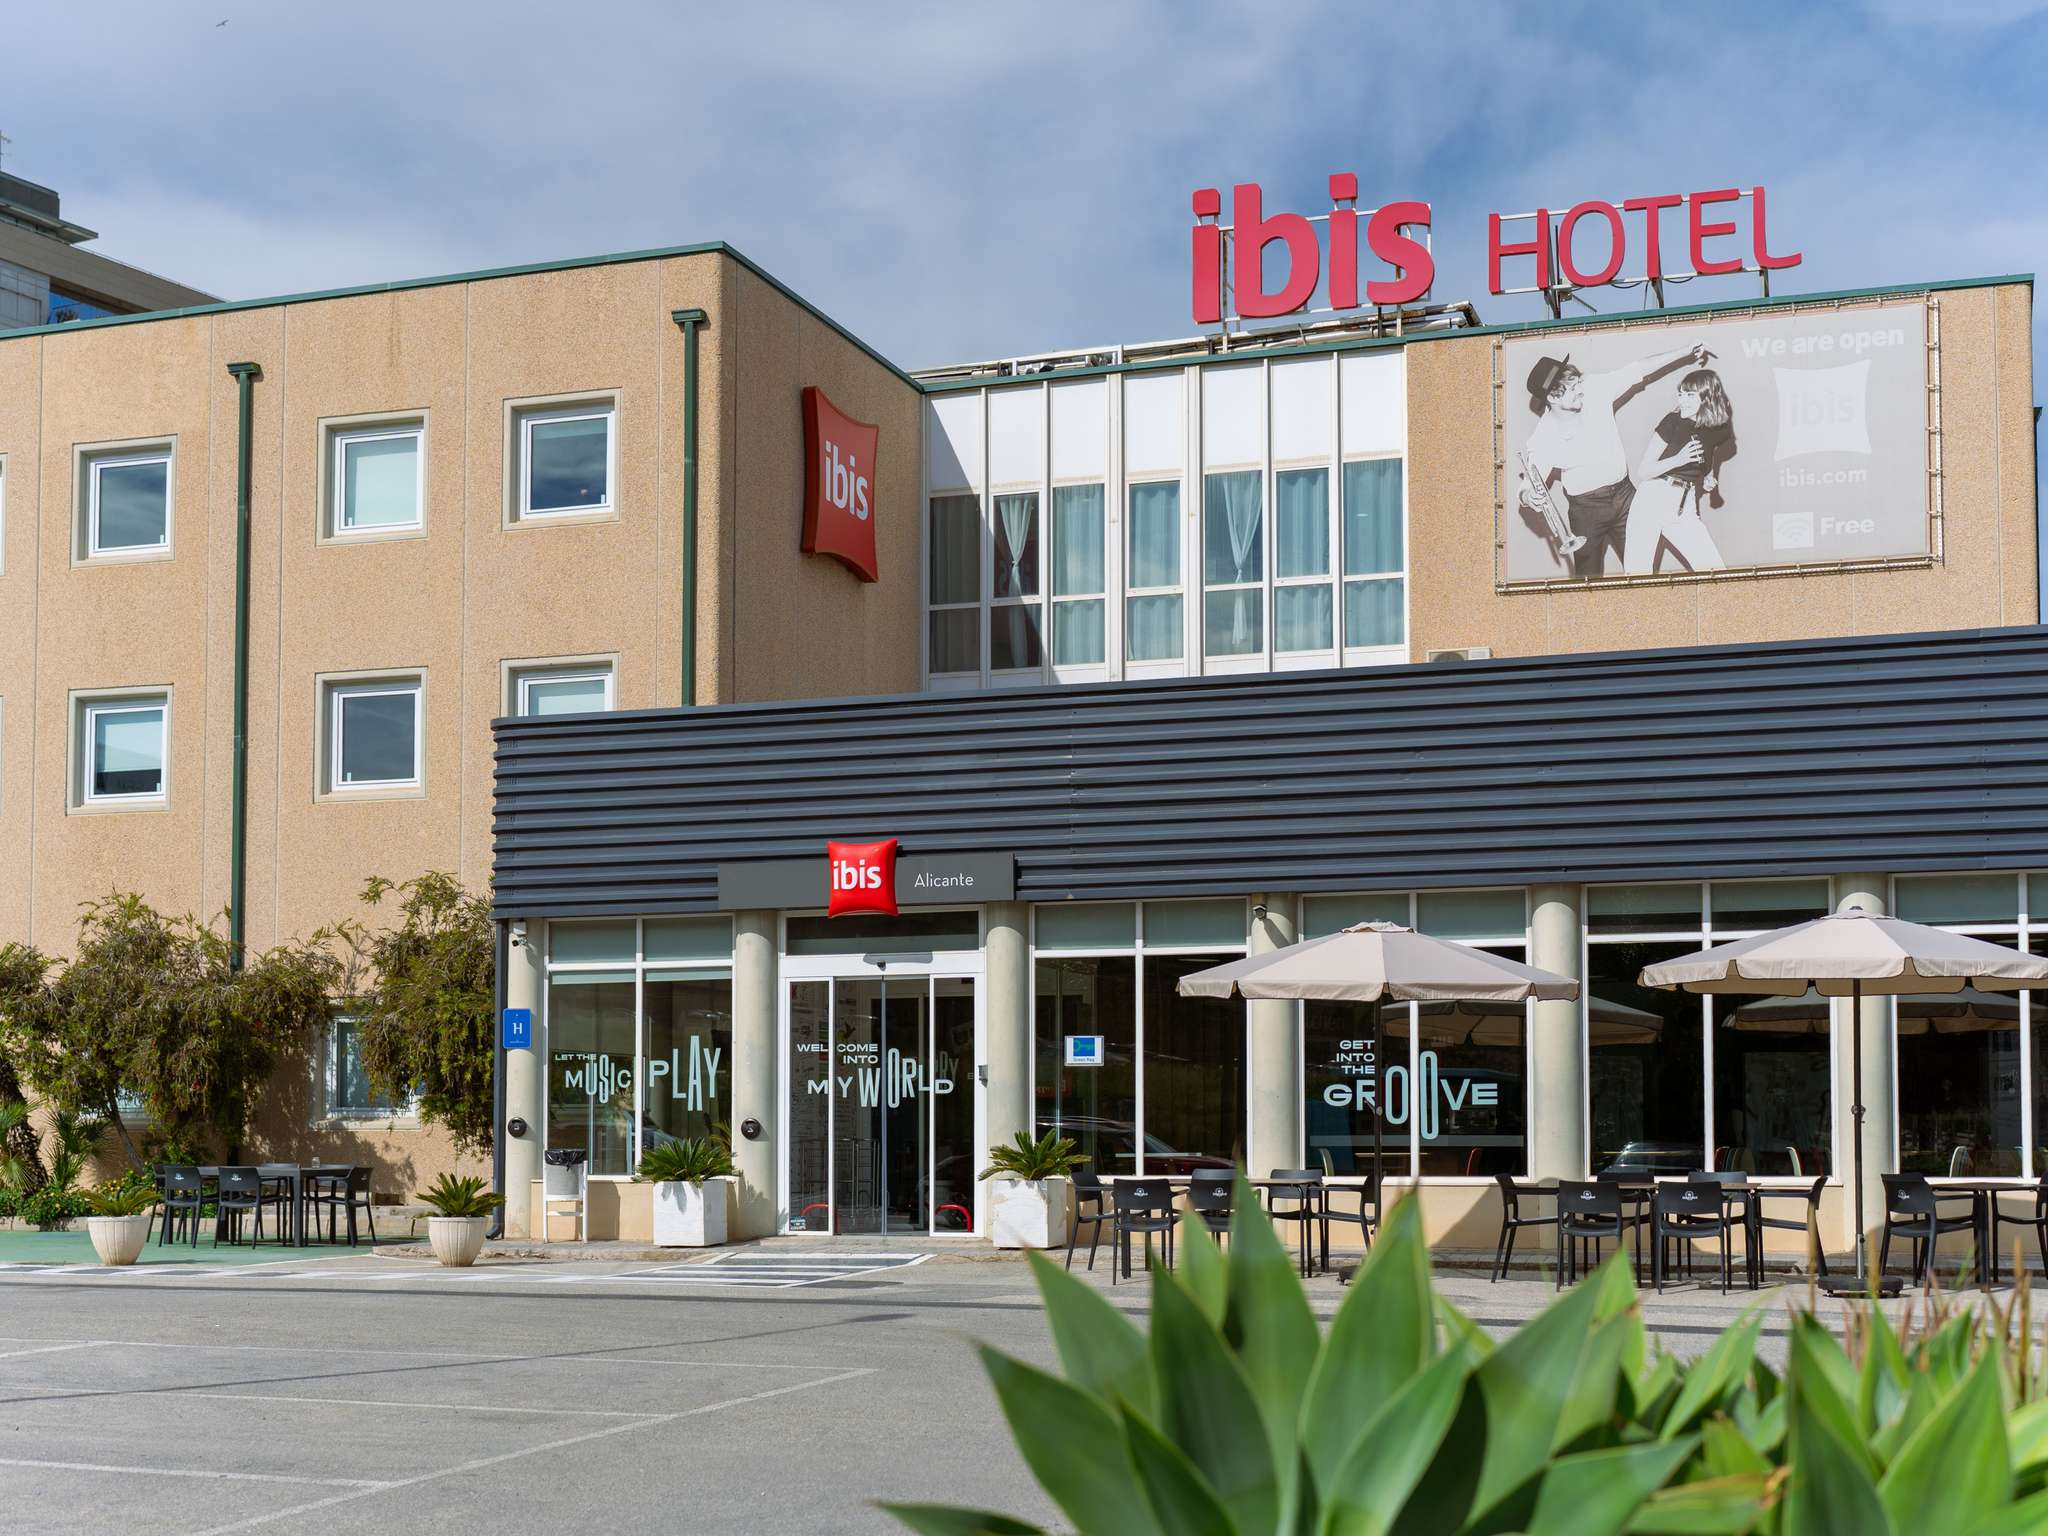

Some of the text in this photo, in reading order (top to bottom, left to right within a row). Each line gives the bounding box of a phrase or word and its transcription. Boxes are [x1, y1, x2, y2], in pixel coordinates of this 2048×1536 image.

[1192, 172, 1802, 324] ibis HOTEL
[1740, 328, 1905, 358] We are open
[825, 440, 869, 521] ibis
[1779, 467, 1868, 488] ibis.com
[1820, 516, 1875, 536] Free
[833, 859, 975, 890] ibis Alicante
[512, 1022, 523, 1035] H
[1339, 1040, 1376, 1050] GET
[576, 1053, 597, 1061] THE
[843, 1055, 879, 1064] INTO
[1336, 1053, 1376, 1063] INTO
[565, 1035, 722, 1112] MUSIC PLAY
[858, 1047, 955, 1109] WORLD
[1341, 1065, 1376, 1075] THE
[1323, 1050, 1499, 1140] GROOVE
